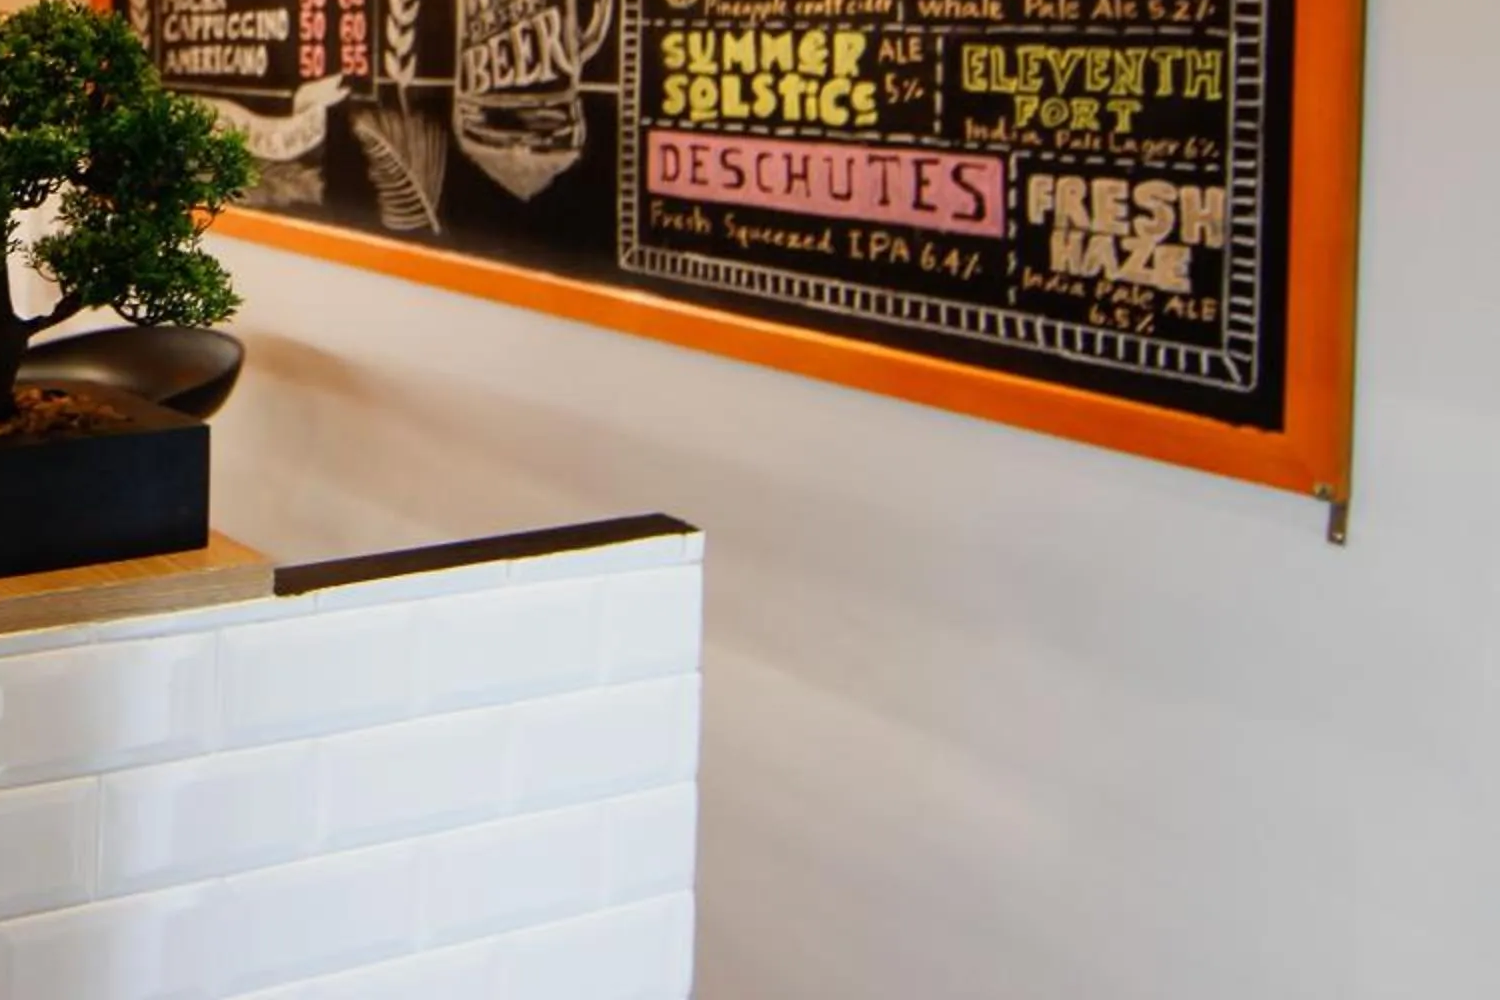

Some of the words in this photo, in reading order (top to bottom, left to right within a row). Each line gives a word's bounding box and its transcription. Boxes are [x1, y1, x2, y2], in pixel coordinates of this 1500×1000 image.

[299, 11, 326, 42] 50
[339, 11, 367, 42] 60
[461, 6, 574, 95] BEER
[661, 28, 866, 77] SUMMER
[877, 36, 924, 65] ALE
[164, 44, 268, 77] AMERICANO
[299, 45, 326, 77] 50
[341, 44, 369, 75] 55
[961, 43, 1223, 100] ELEVENTH
[964, 115, 1043, 146] India
[1055, 129, 1100, 151] Pale
[1014, 95, 1143, 133] FORT
[659, 142, 989, 223] DESCHUTES
[650, 199, 713, 234] Fresh
[723, 212, 836, 254] Squeezed
[849, 230, 910, 264] IPA
[1027, 173, 1226, 249] FRESH
[1050, 229, 1192, 294] HAZE
[1164, 295, 1218, 322] ALE
